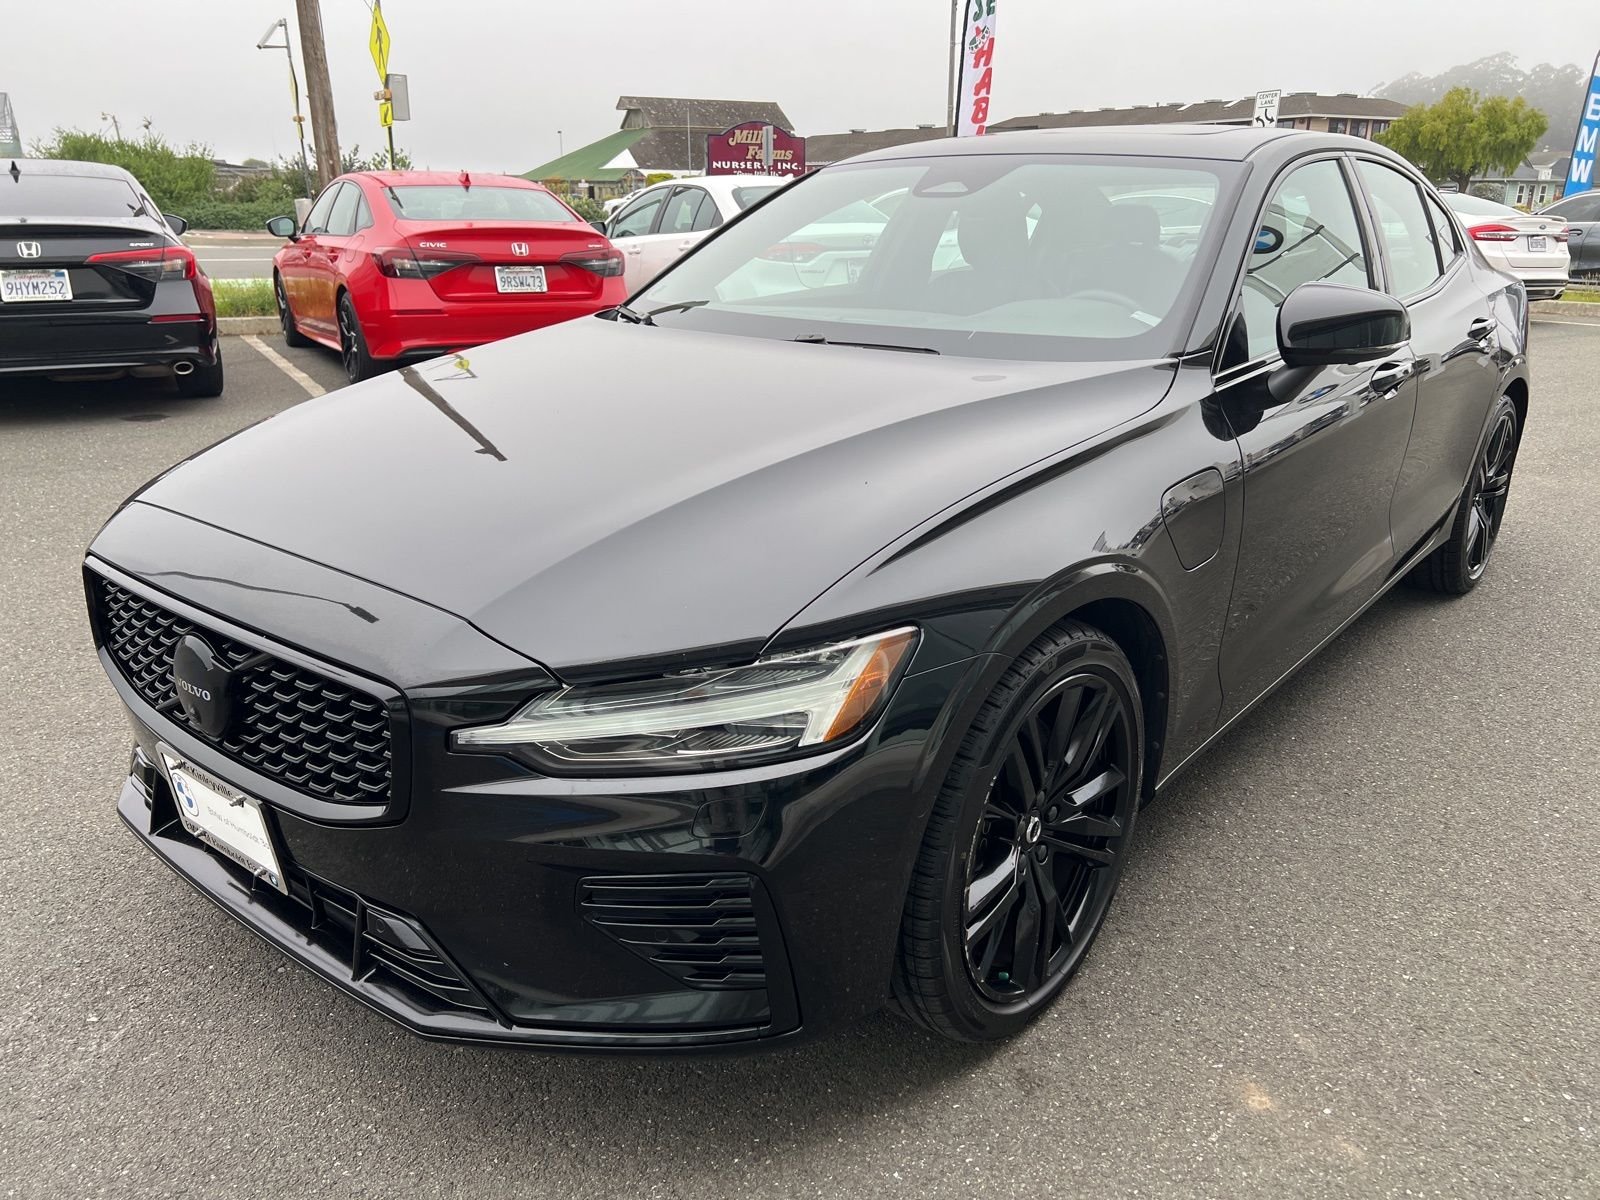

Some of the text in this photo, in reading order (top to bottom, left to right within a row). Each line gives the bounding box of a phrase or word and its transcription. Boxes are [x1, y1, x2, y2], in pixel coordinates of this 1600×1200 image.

[1258, 92, 1278, 100] CENTER
[728, 129, 777, 146] Mill
[746, 145, 794, 161] Fams
[777, 162, 802, 171] INC.
[6, 280, 66, 296] 9HYM252
[500, 275, 543, 288] 9RSW473
[178, 678, 211, 701] VOLVO
